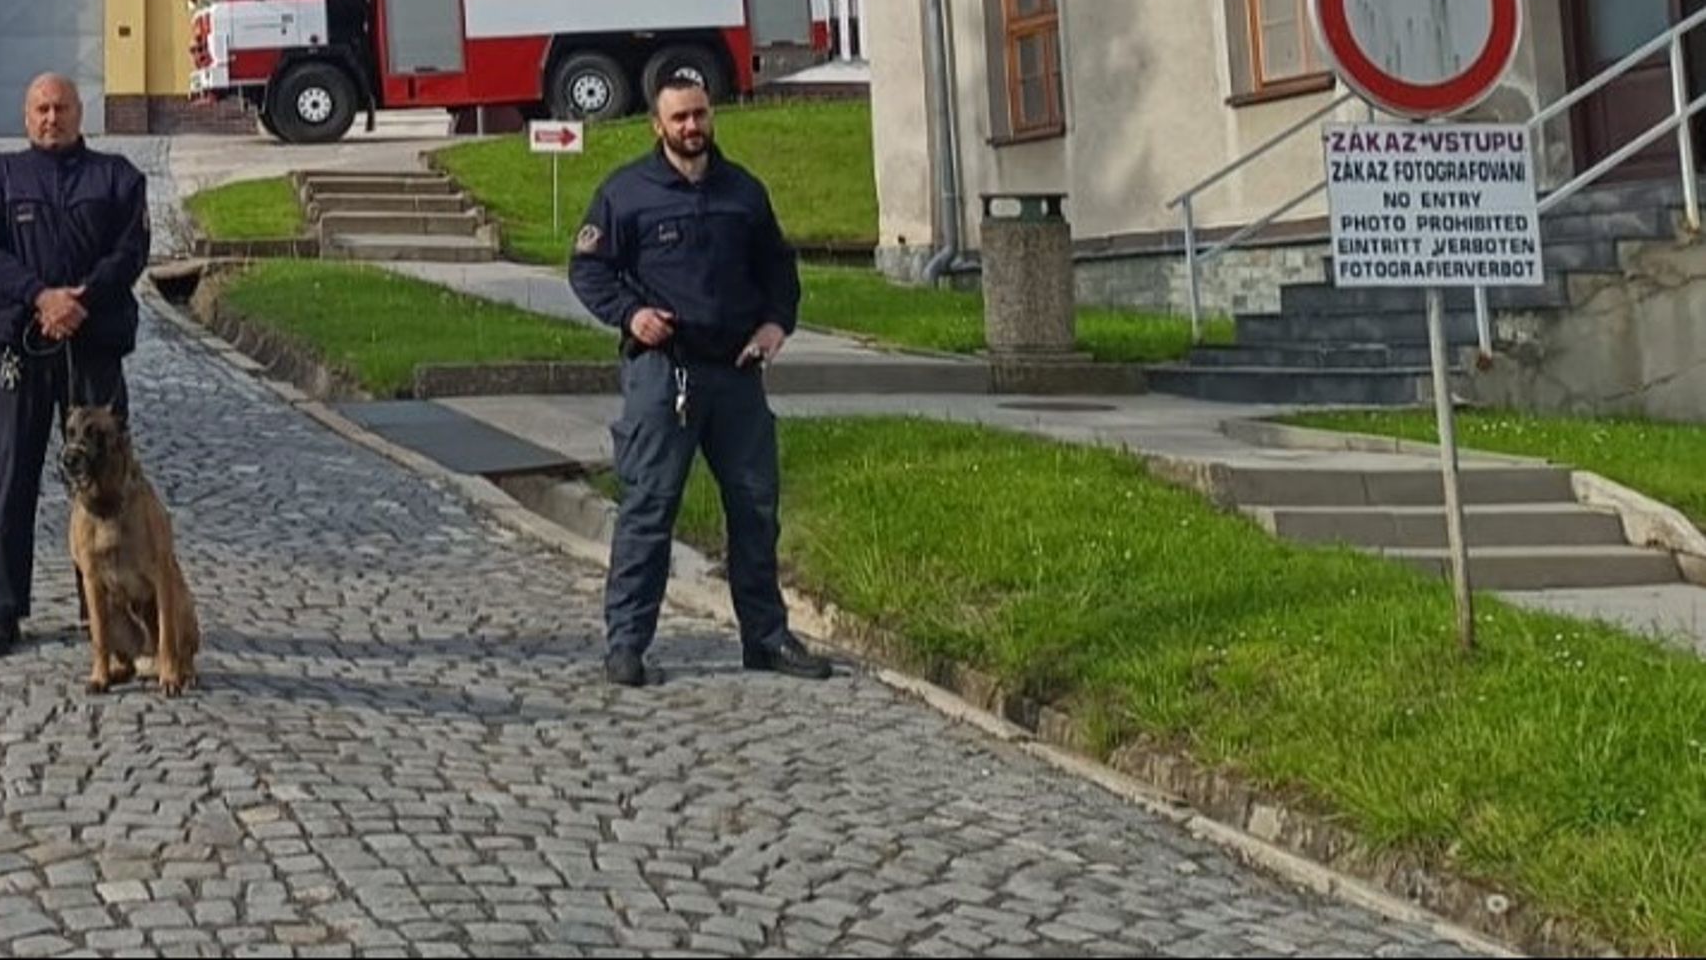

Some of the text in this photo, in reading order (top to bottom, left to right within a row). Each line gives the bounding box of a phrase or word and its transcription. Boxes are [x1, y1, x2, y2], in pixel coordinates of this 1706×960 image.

[1428, 131, 1523, 153] VSTUPU
[1383, 191, 1482, 209] NO ENTRY
[1341, 214, 1528, 232] PHOTO PROHIBITED
[1338, 238, 1535, 255] EINTRITT VERBOTEN
[1340, 261, 1534, 278] FOTOGRAFIERVERBOT
